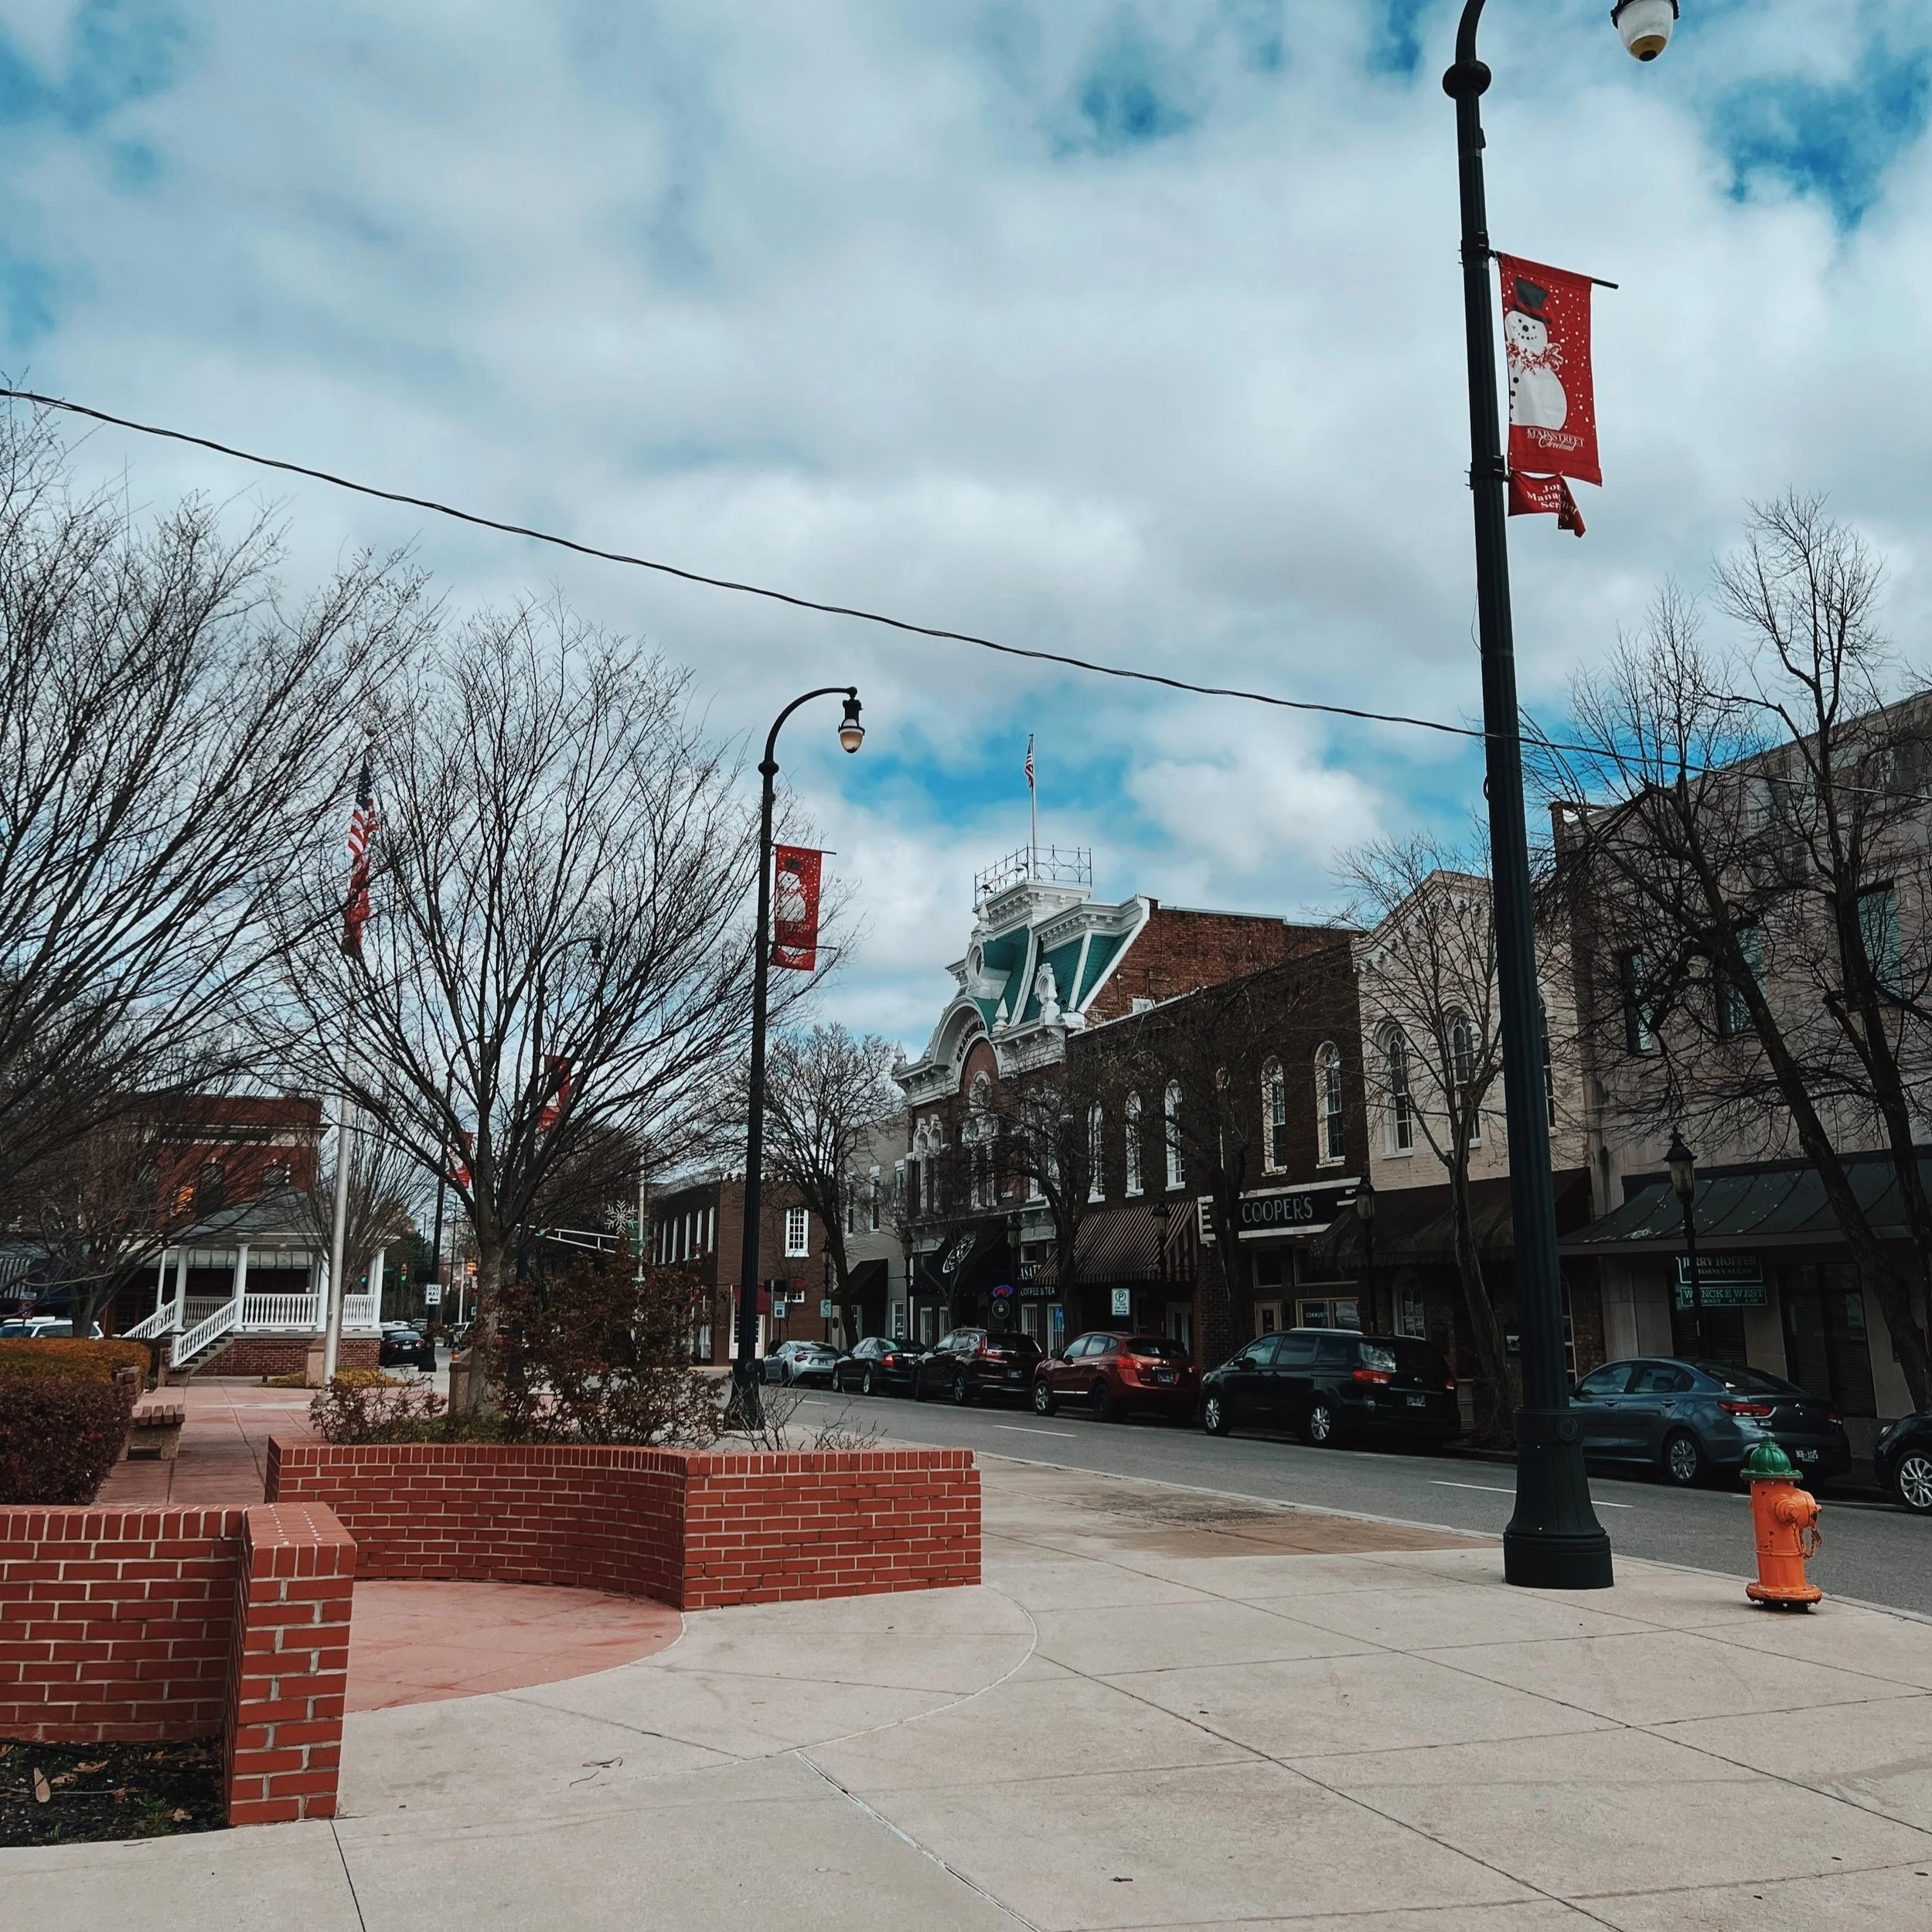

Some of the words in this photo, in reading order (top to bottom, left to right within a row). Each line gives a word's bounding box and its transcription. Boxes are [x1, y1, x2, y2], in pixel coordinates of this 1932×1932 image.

[1242, 1195, 1313, 1223] COOPER'S
[1021, 1287, 1039, 1297] COFFEE
[1045, 1286, 1055, 1296] TEA
[1733, 1289, 1763, 1298] WEST
